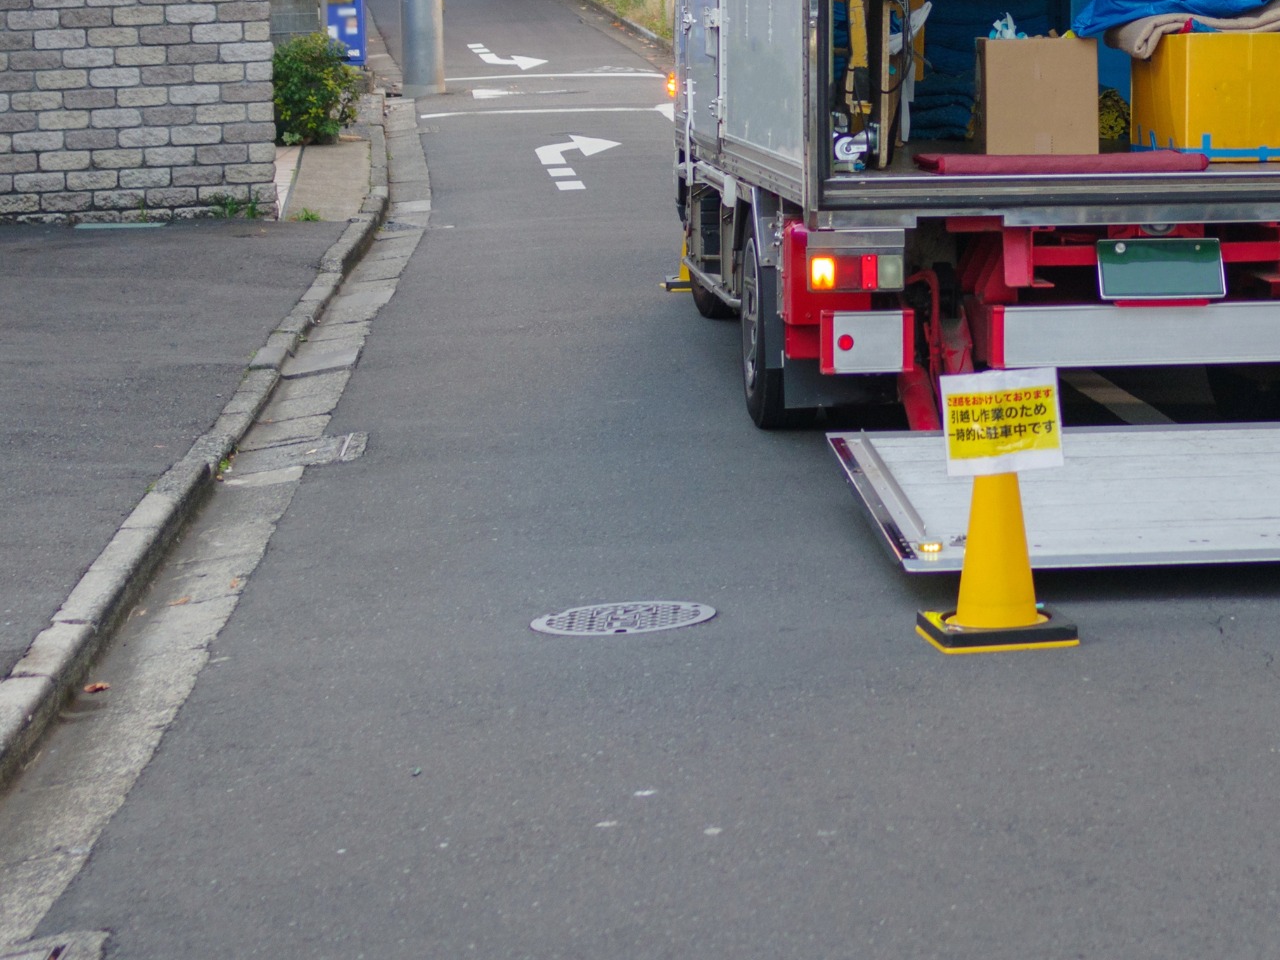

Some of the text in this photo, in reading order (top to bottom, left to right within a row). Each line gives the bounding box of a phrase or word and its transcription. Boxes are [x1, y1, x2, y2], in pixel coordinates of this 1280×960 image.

[947, 388, 1052, 407] ご迷惑をおかけしております
[951, 403, 1047, 424] 引越し作業のため
[948, 420, 1055, 441] 一時的に駐車中です
